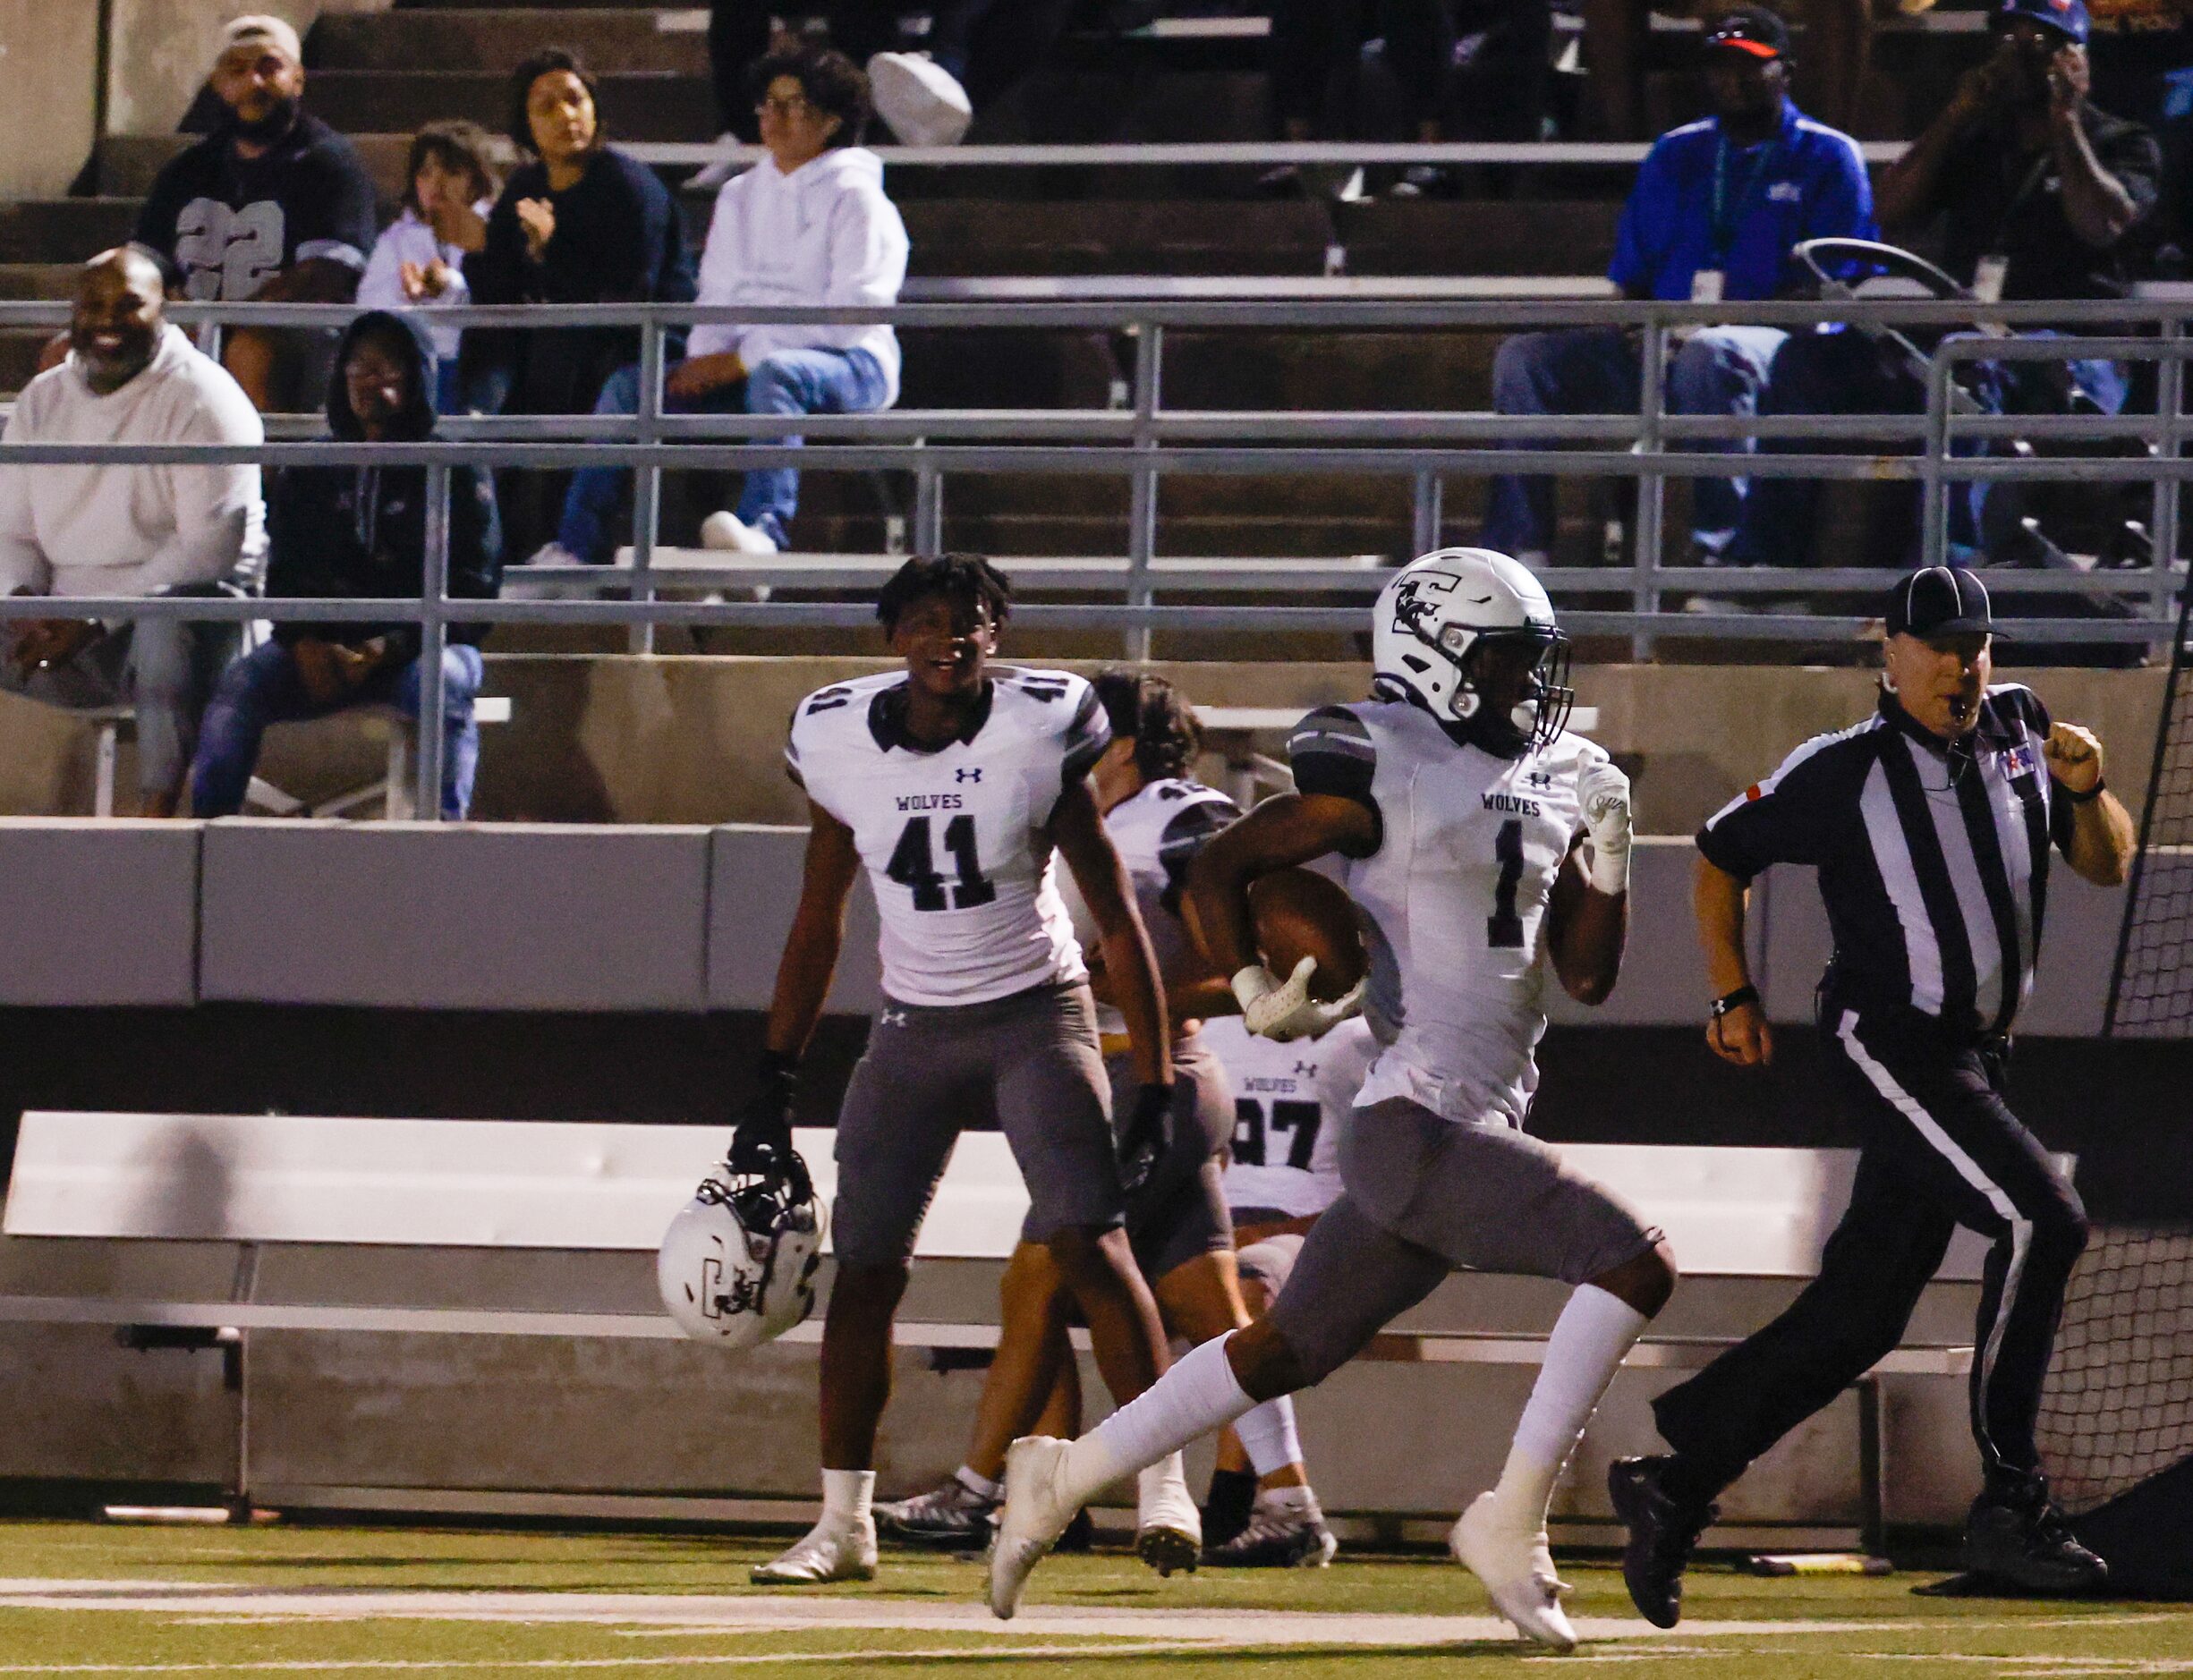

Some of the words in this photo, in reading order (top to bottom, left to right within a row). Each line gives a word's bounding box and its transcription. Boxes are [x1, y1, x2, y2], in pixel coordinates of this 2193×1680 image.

[896, 793, 963, 811] WOLVES
[1481, 793, 1541, 817] WOLVES
[885, 814, 997, 912] 41
[1487, 819, 1525, 947] 1
